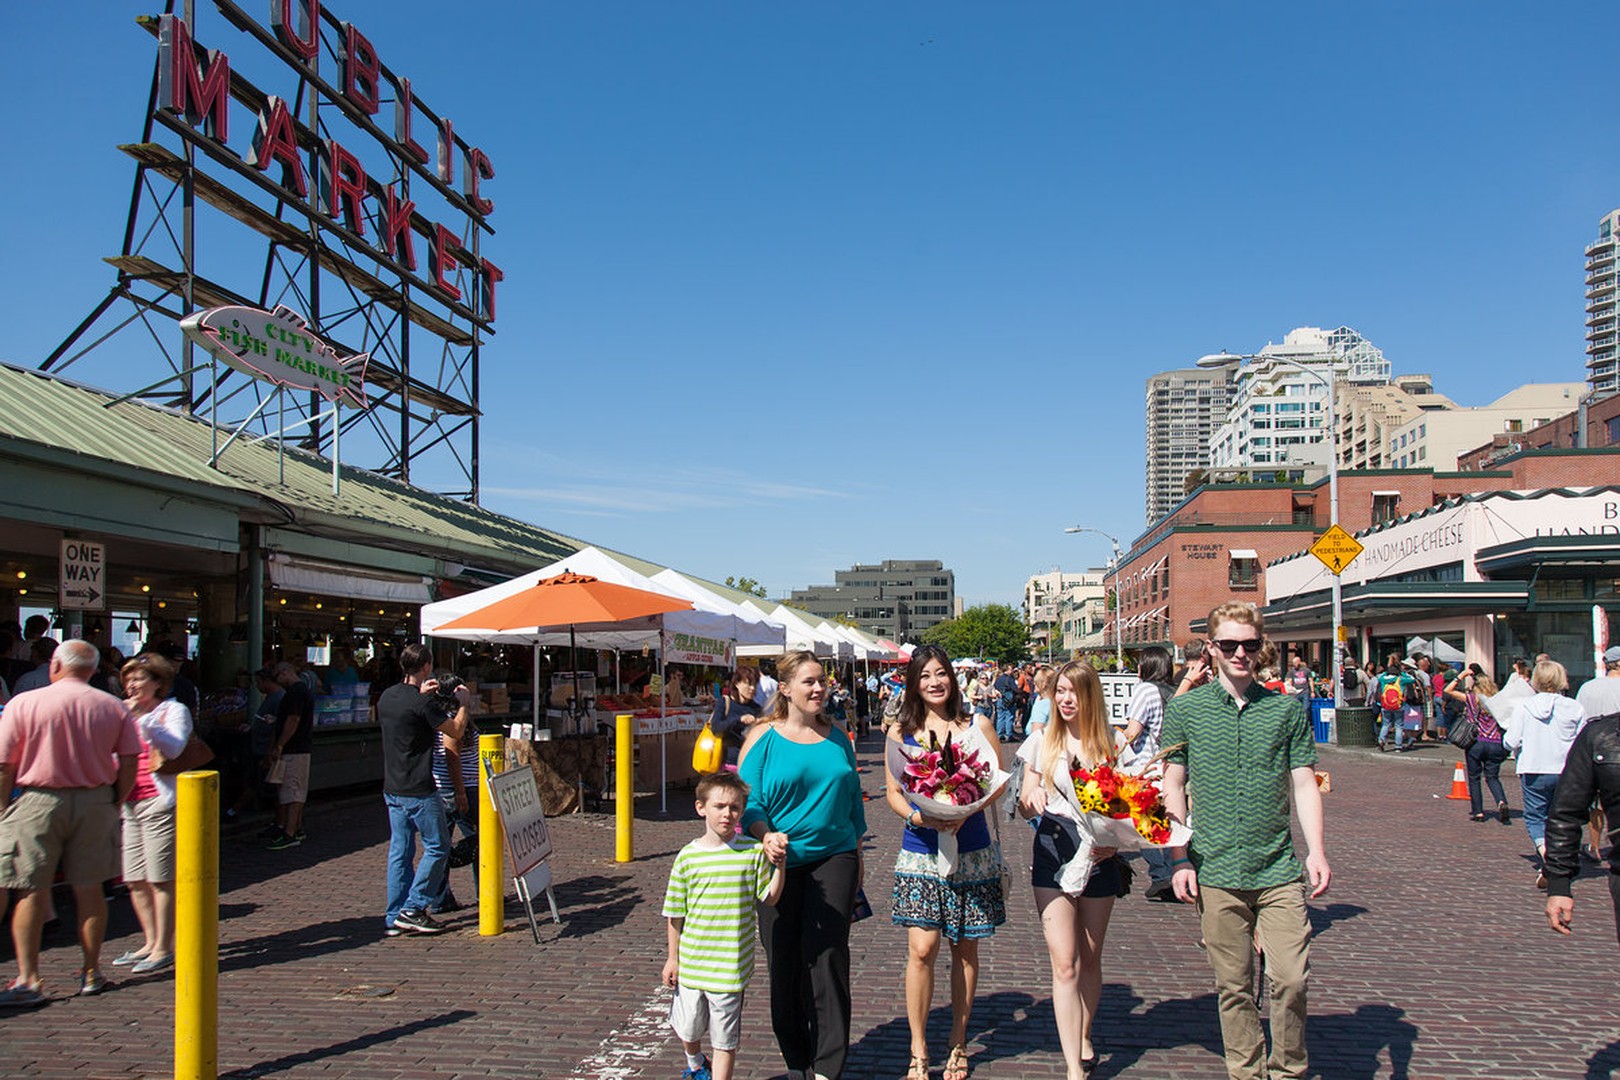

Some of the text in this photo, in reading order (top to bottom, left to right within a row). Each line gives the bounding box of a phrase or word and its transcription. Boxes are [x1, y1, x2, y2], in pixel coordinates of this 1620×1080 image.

[159, 14, 503, 322] MARKET
[218, 326, 351, 387] FISH MARKET
[265, 323, 315, 353] CITY
[66, 544, 101, 563] ONE
[1187, 552, 1217, 560] HOUSE
[1364, 535, 1418, 566] HANDMADE
[1422, 522, 1464, 552] CHEESE
[65, 564, 101, 582] WAY
[501, 779, 536, 816] STREET
[512, 819, 547, 860] CLOSED
